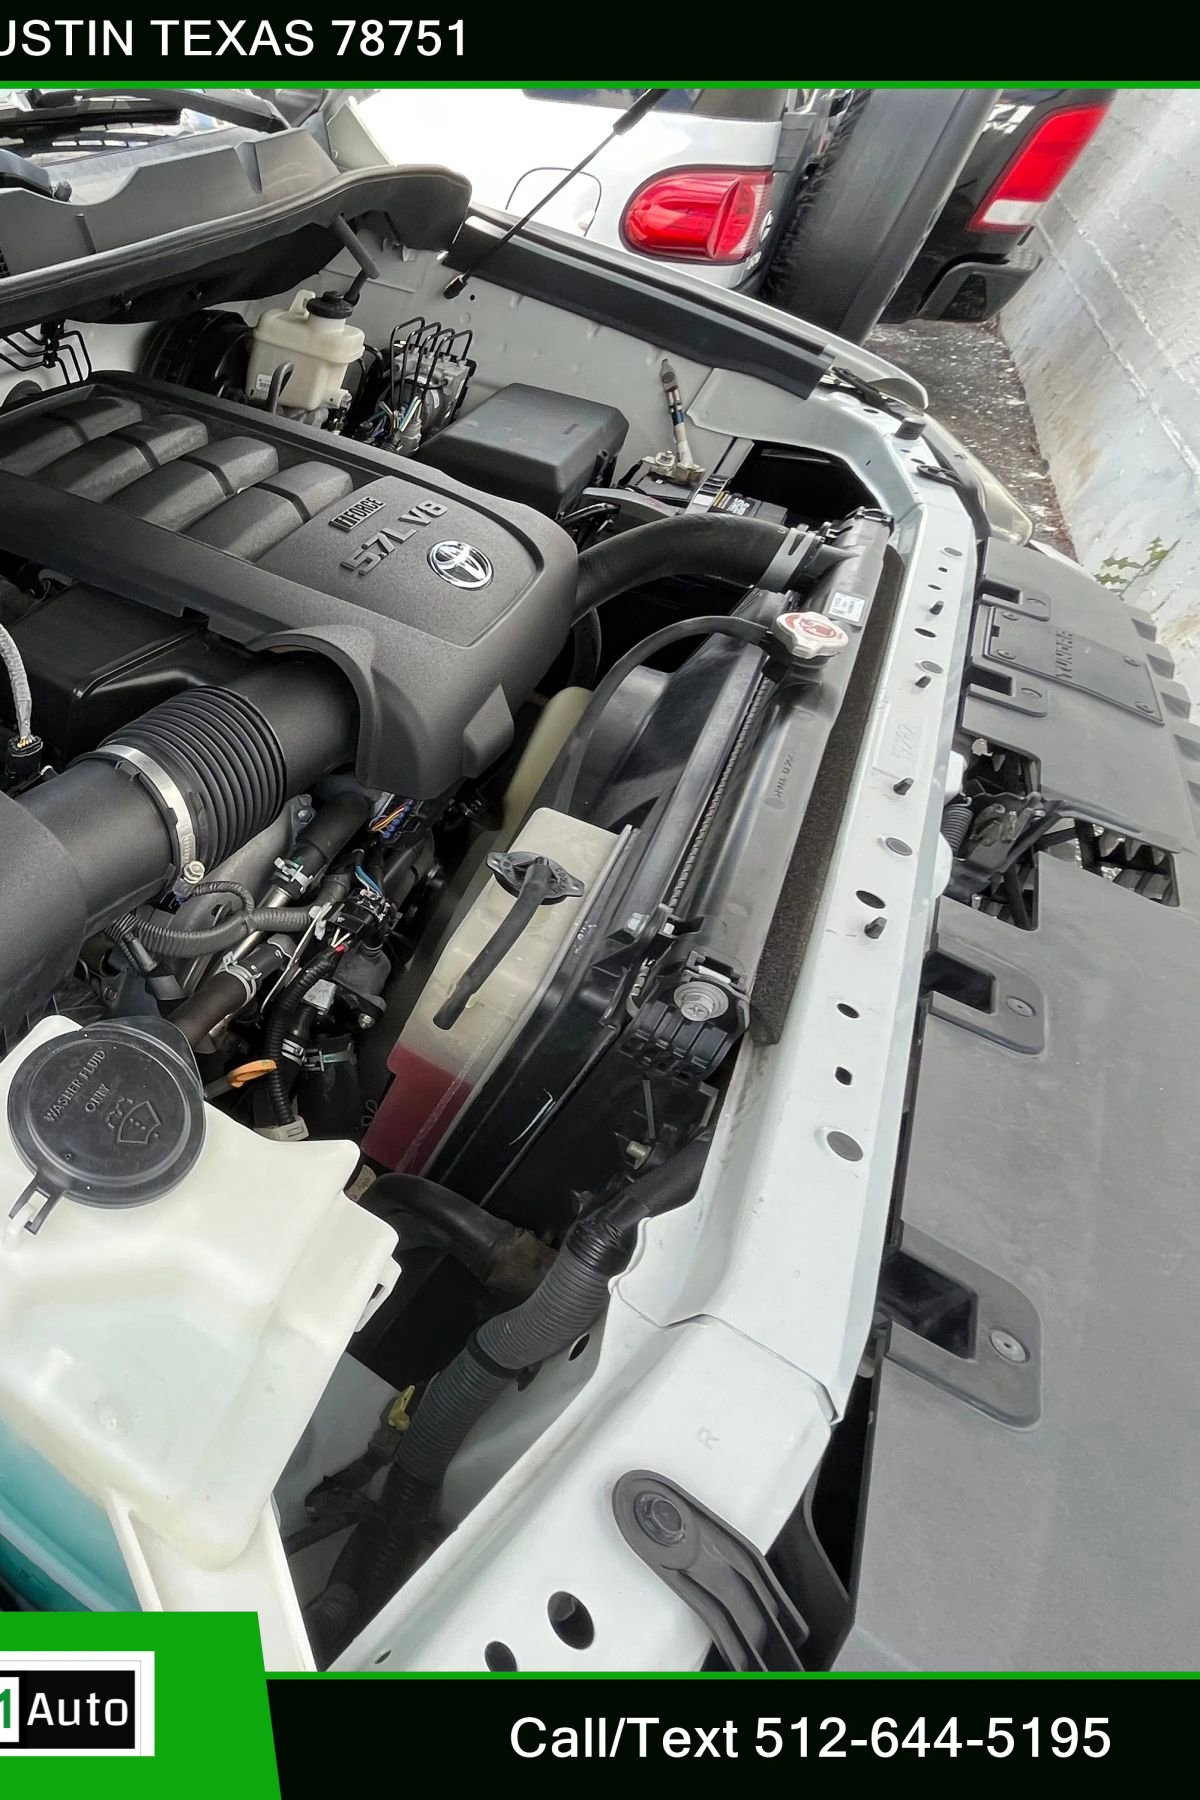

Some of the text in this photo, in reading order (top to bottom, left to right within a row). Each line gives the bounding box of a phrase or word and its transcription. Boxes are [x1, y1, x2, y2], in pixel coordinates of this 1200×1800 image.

[340, 500, 448, 577] 5.7L V8
[43, 1049, 107, 1123] WASHER FLUID
[85, 1082, 111, 1113] ONLY
